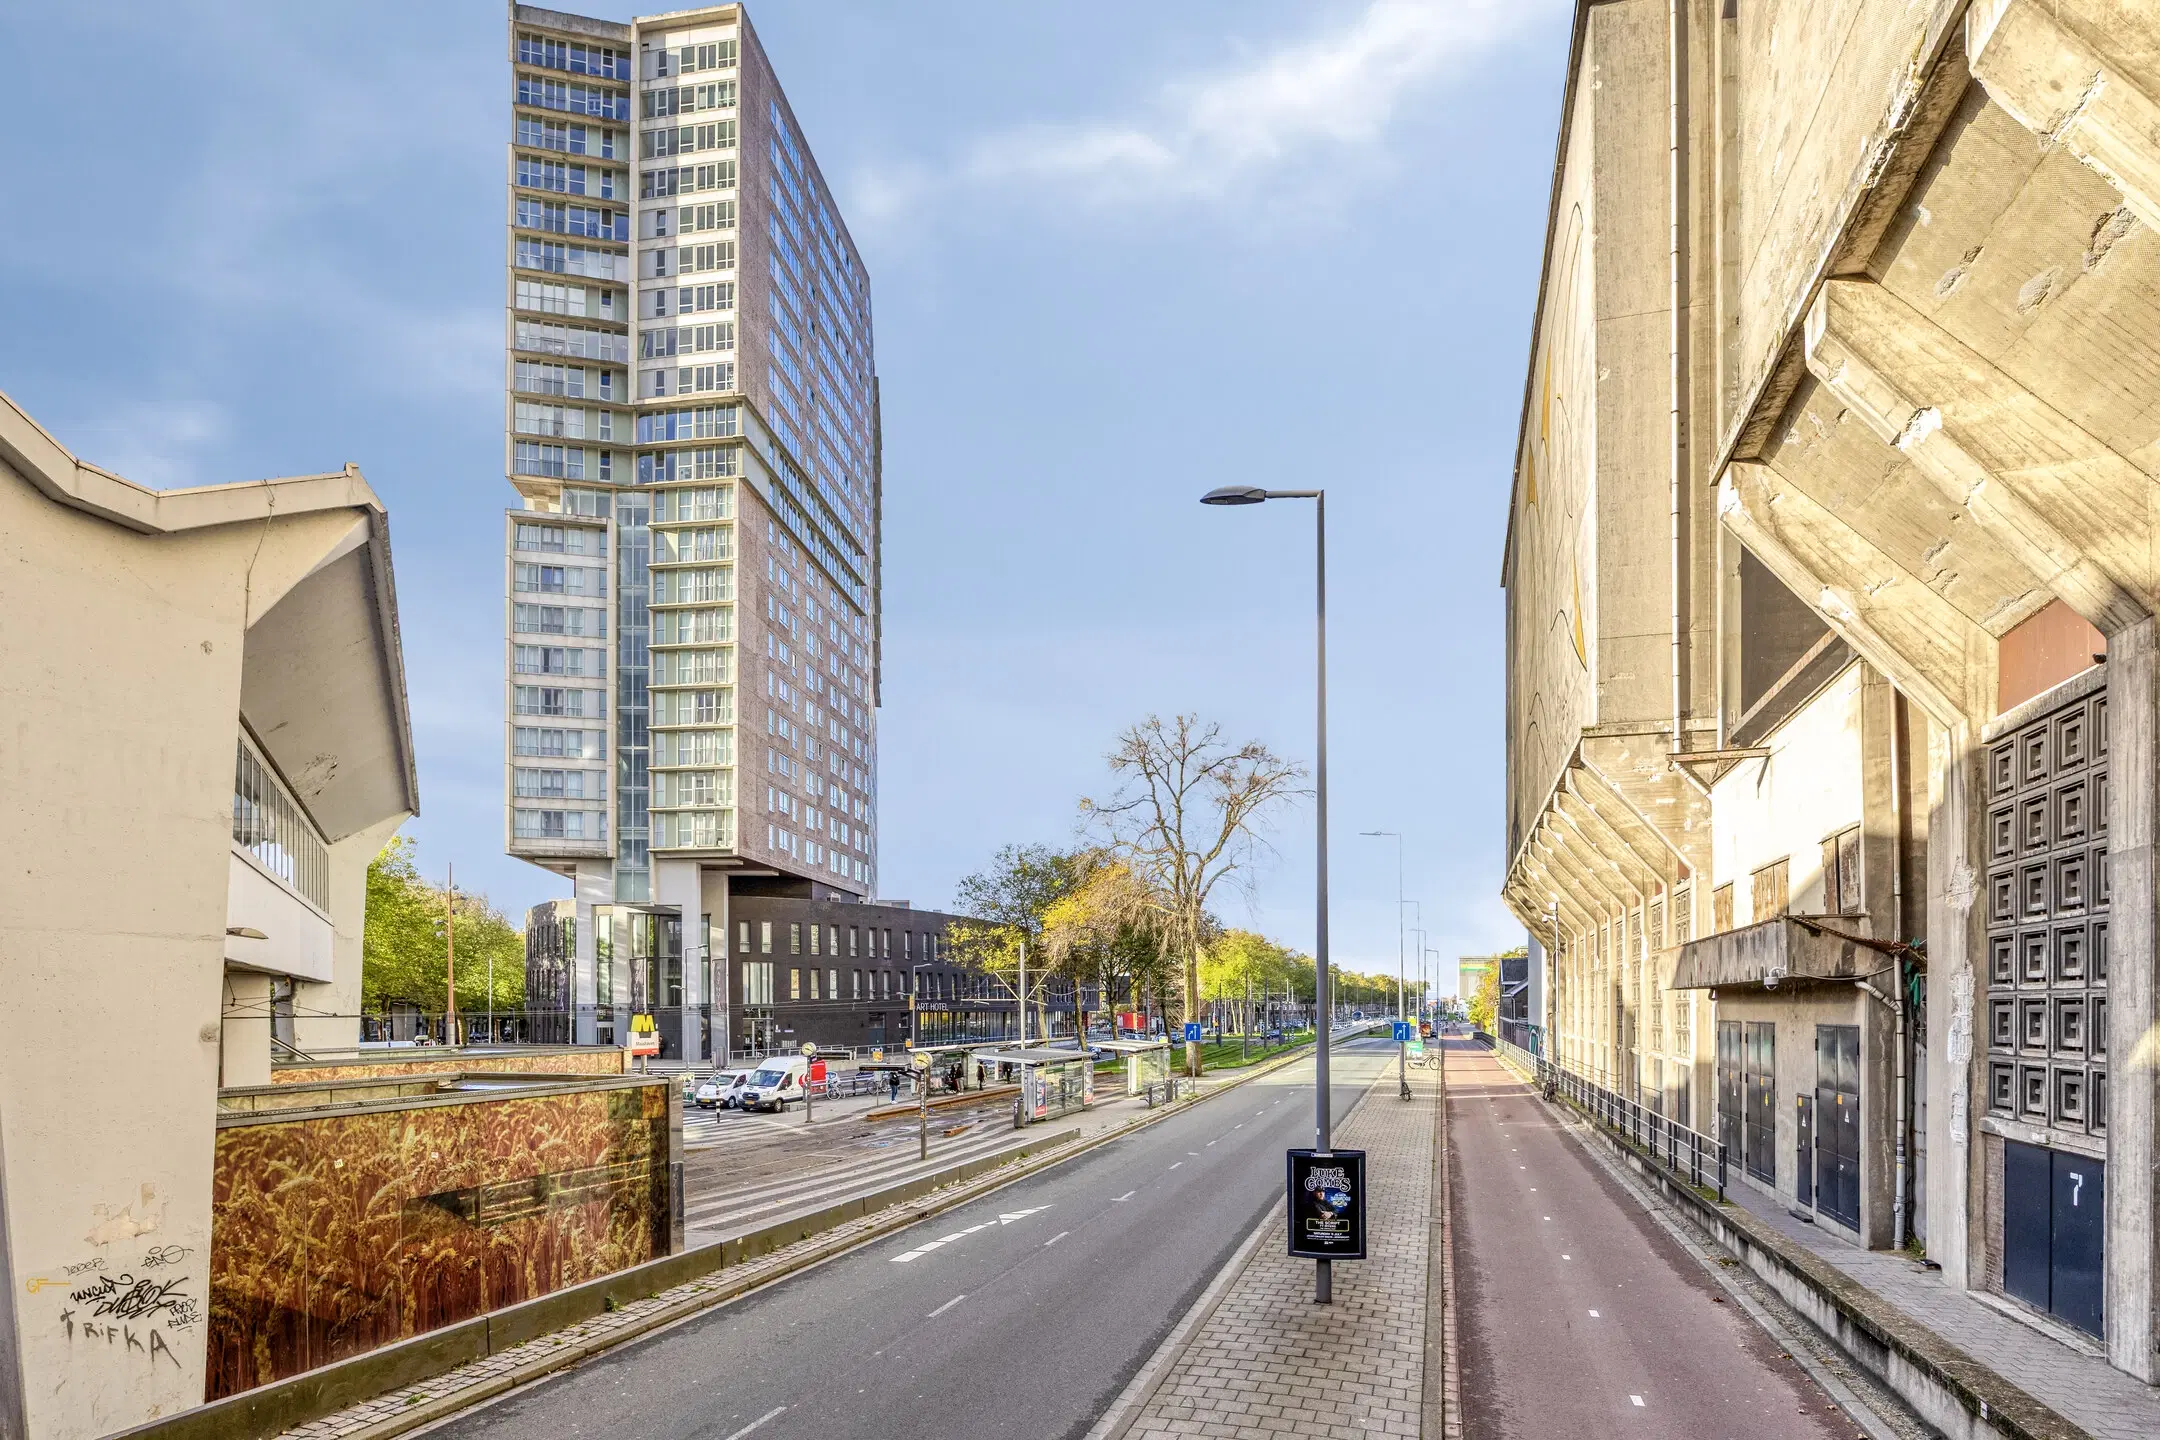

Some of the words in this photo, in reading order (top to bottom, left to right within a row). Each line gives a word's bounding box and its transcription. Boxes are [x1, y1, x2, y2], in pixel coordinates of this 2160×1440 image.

[916, 1003, 928, 1011] ART
[930, 1003, 949, 1011] HOTEL
[1310, 1166, 1345, 1178] LUKE
[2069, 1172, 2083, 1206] 7
